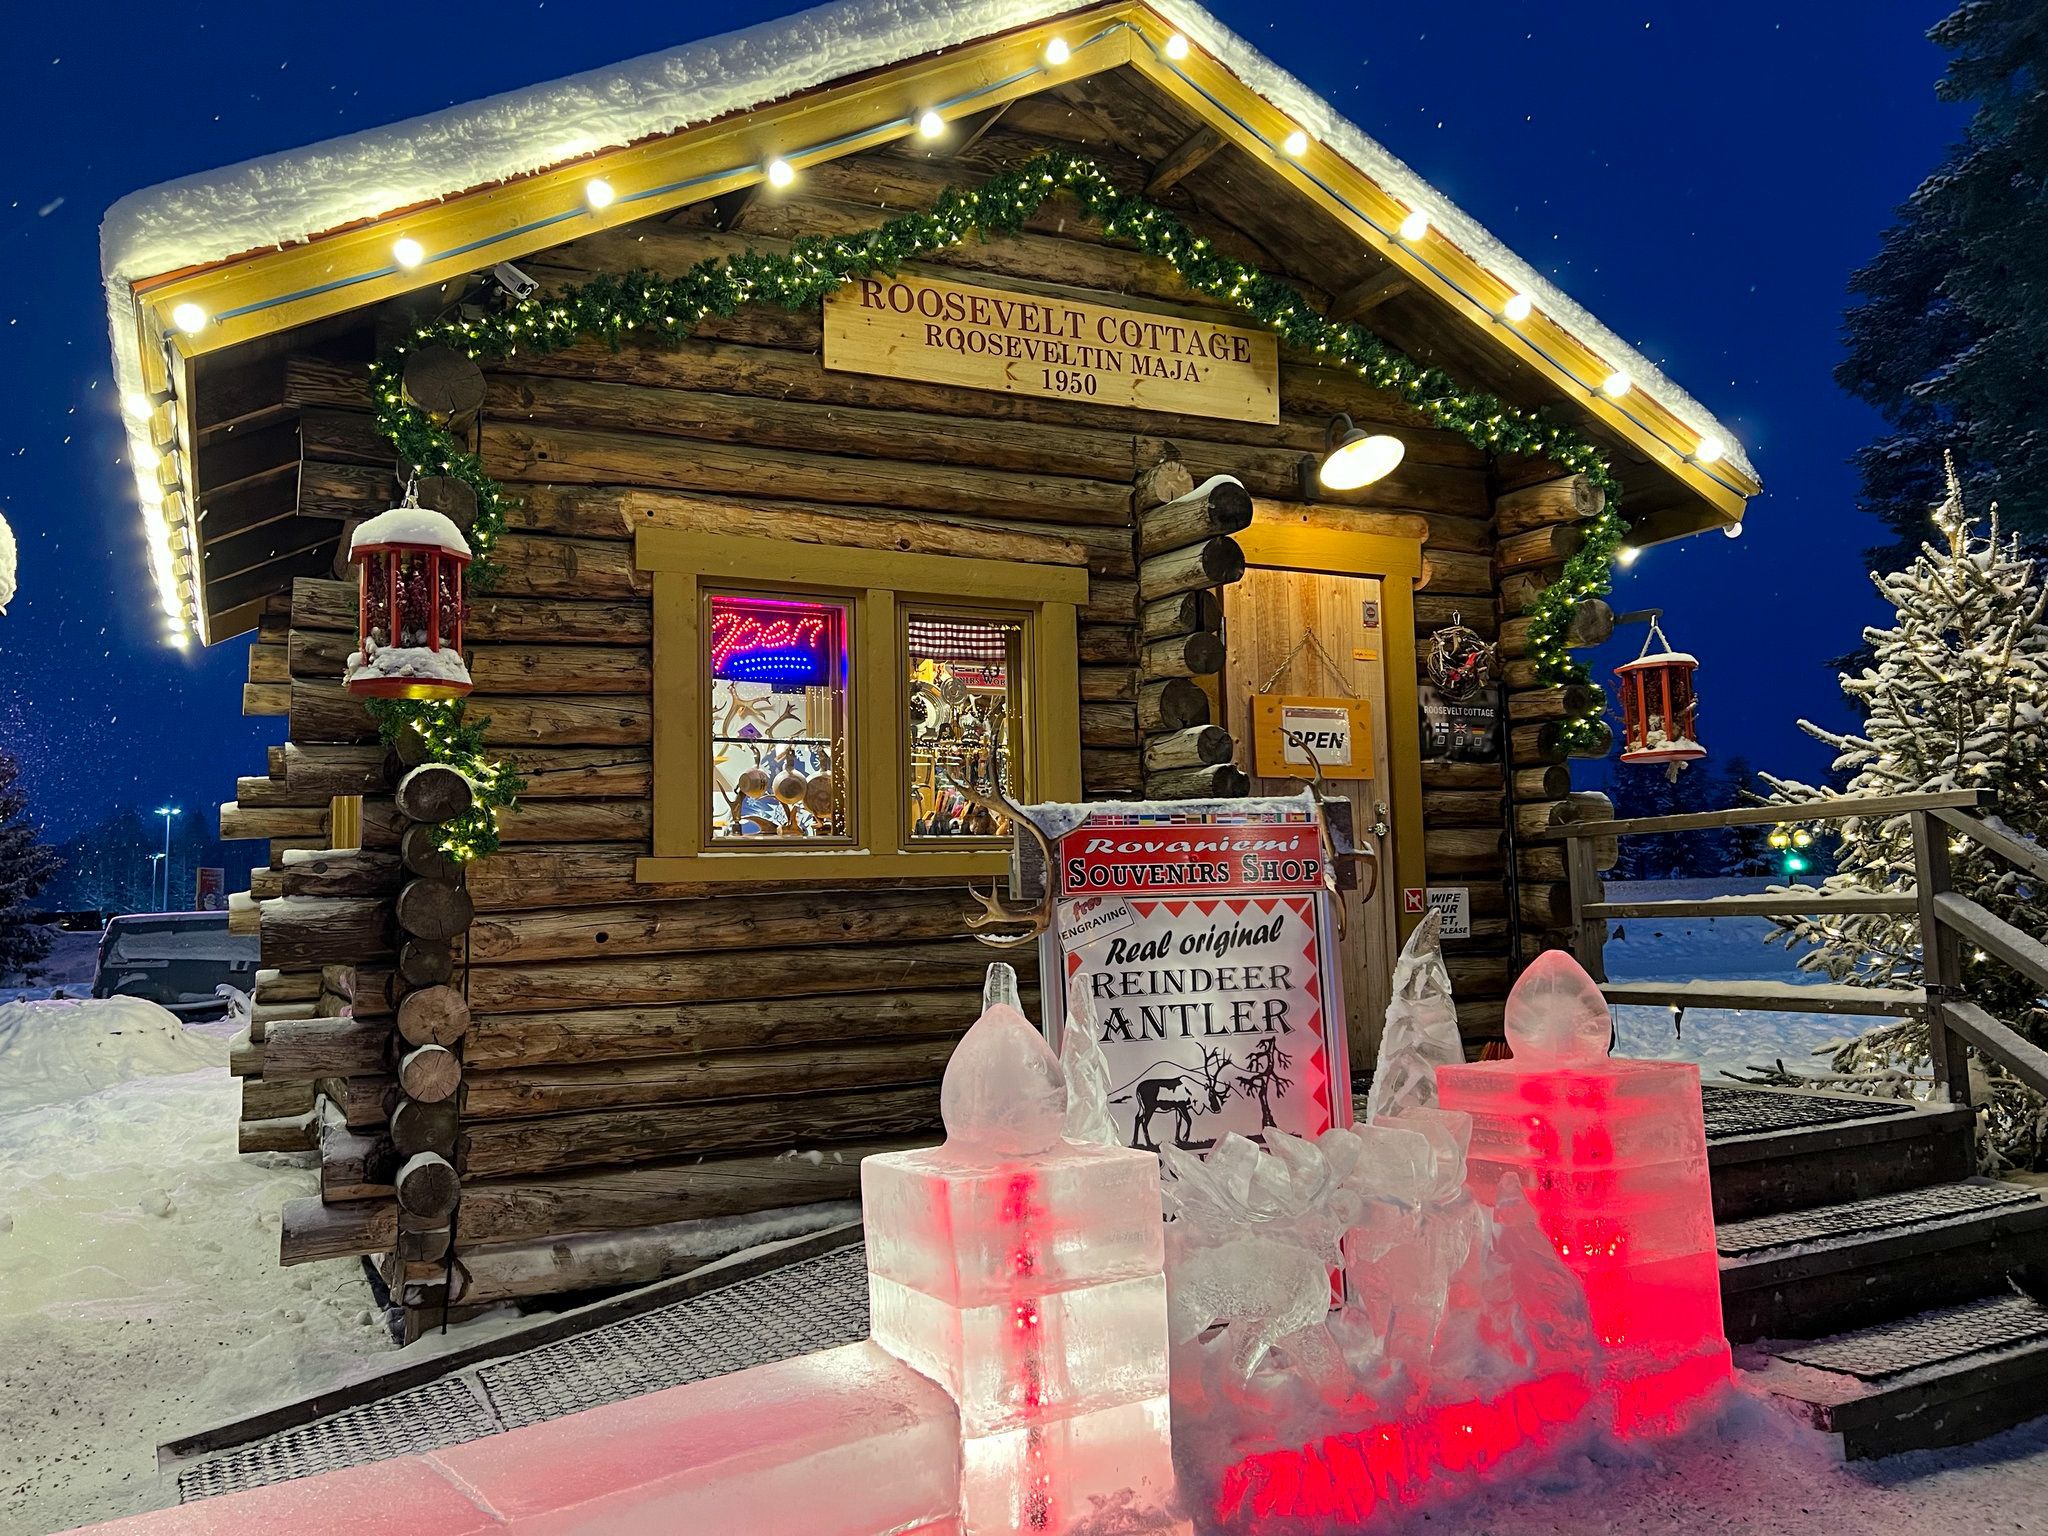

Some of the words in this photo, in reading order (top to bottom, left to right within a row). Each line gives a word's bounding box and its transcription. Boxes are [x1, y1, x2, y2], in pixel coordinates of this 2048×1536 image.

[858, 278, 1086, 340] ROOSEVELT
[1096, 316, 1251, 363] COTTAGE
[924, 323, 1123, 373] ROOSEVELTIN
[1130, 352, 1201, 383] MAJA
[1042, 368, 1097, 396] 1950
[1423, 705, 1463, 716] ROOSEVELT
[1463, 707, 1495, 718] COTTAGE
[1288, 730, 1345, 749] OPEN
[1084, 835, 1299, 854] Rovaniemi
[1068, 857, 1231, 888] SOUVENIRS
[1240, 853, 1320, 884] SHOP
[1431, 893, 1462, 903] WIPE
[1061, 906, 1127, 940] ENGRAVING
[1104, 930, 1173, 966] Real
[1179, 914, 1285, 958] original
[1440, 926, 1468, 935] PLEASE
[1090, 964, 1296, 1000] REINDEER
[1099, 998, 1296, 1044] ANTLER
